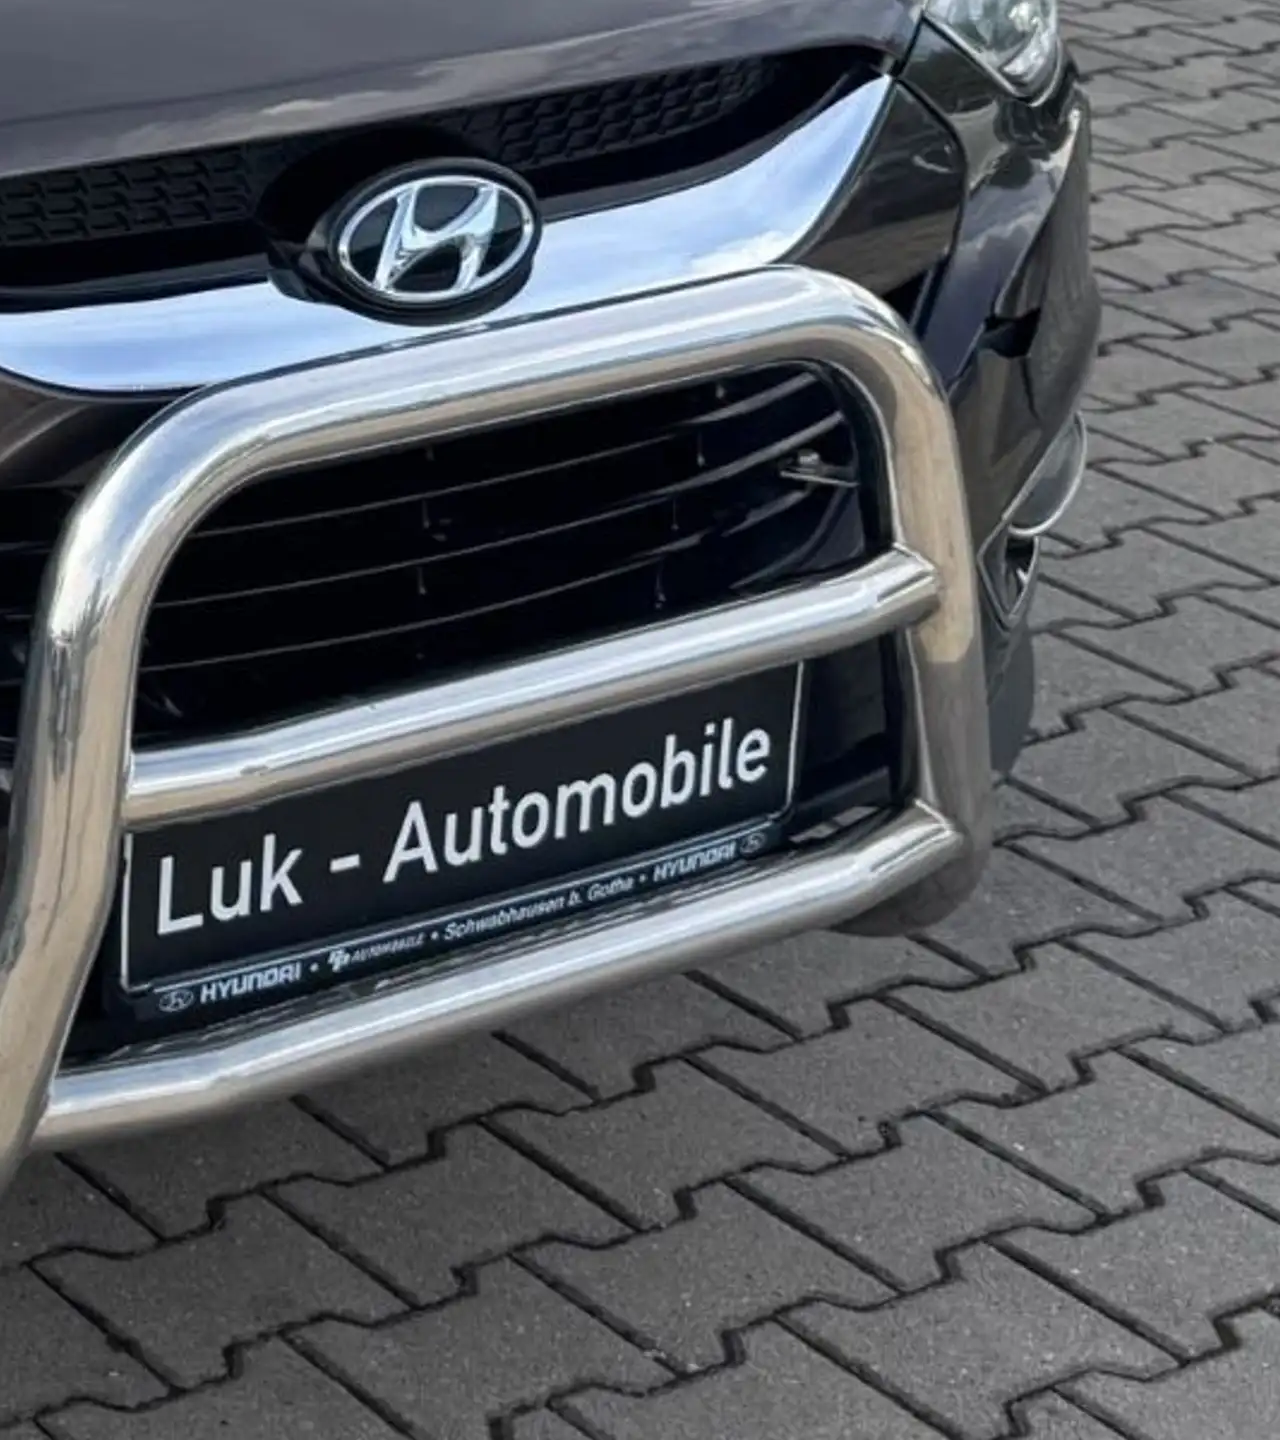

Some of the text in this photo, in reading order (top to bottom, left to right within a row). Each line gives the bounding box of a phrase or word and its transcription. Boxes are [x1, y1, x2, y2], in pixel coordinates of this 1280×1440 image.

[156, 833, 304, 936] Luk
[382, 717, 771, 883] Automobile
[199, 962, 302, 1004] HYUNDAI
[443, 895, 565, 941] Schwabhausen
[587, 876, 634, 902] Gotha
[652, 841, 736, 882] HYUNDAI
